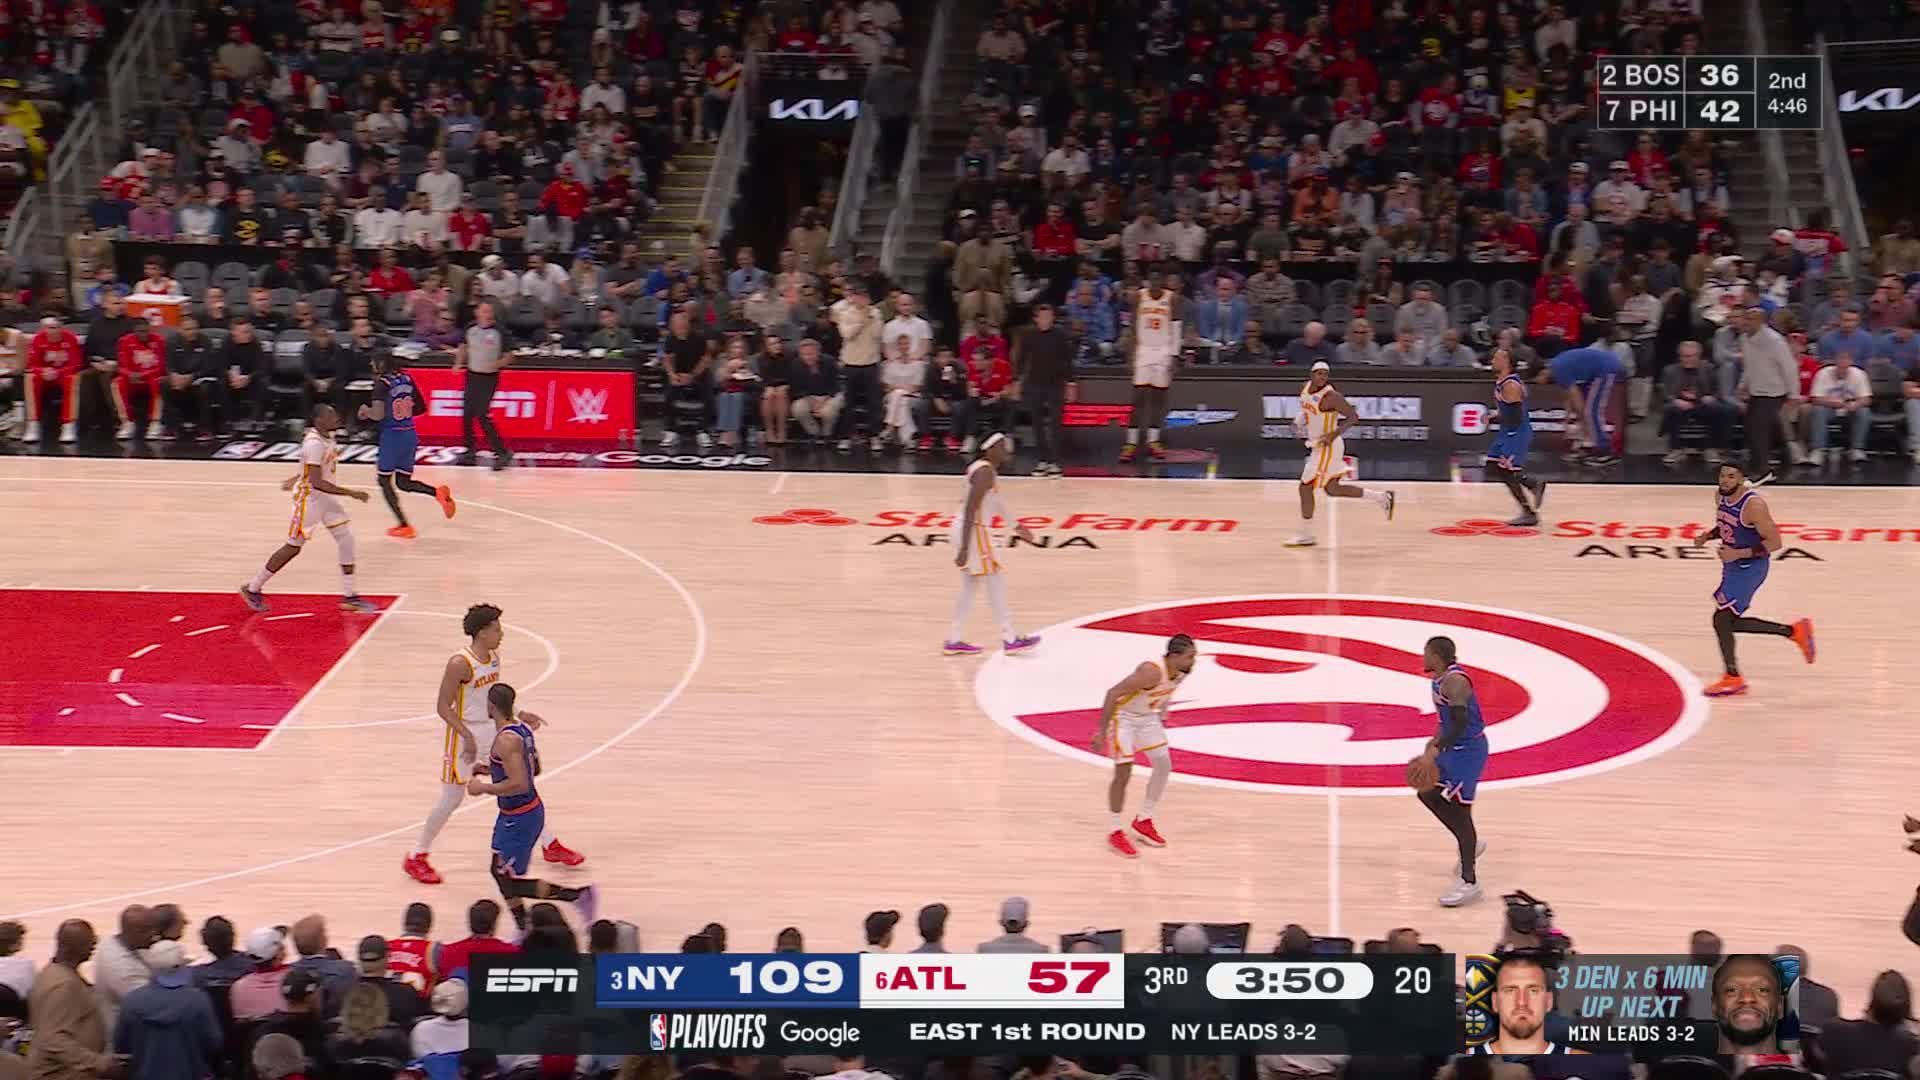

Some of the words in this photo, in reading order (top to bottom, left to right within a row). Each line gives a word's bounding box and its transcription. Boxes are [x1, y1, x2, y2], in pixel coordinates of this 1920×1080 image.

[430, 389, 536, 418] EPN
[596, 450, 772, 467] Google
[866, 511, 1054, 529] Stte
[1056, 513, 1240, 532] Farm
[1550, 520, 1706, 540] Stat
[1574, 544, 1826, 561] AREA
